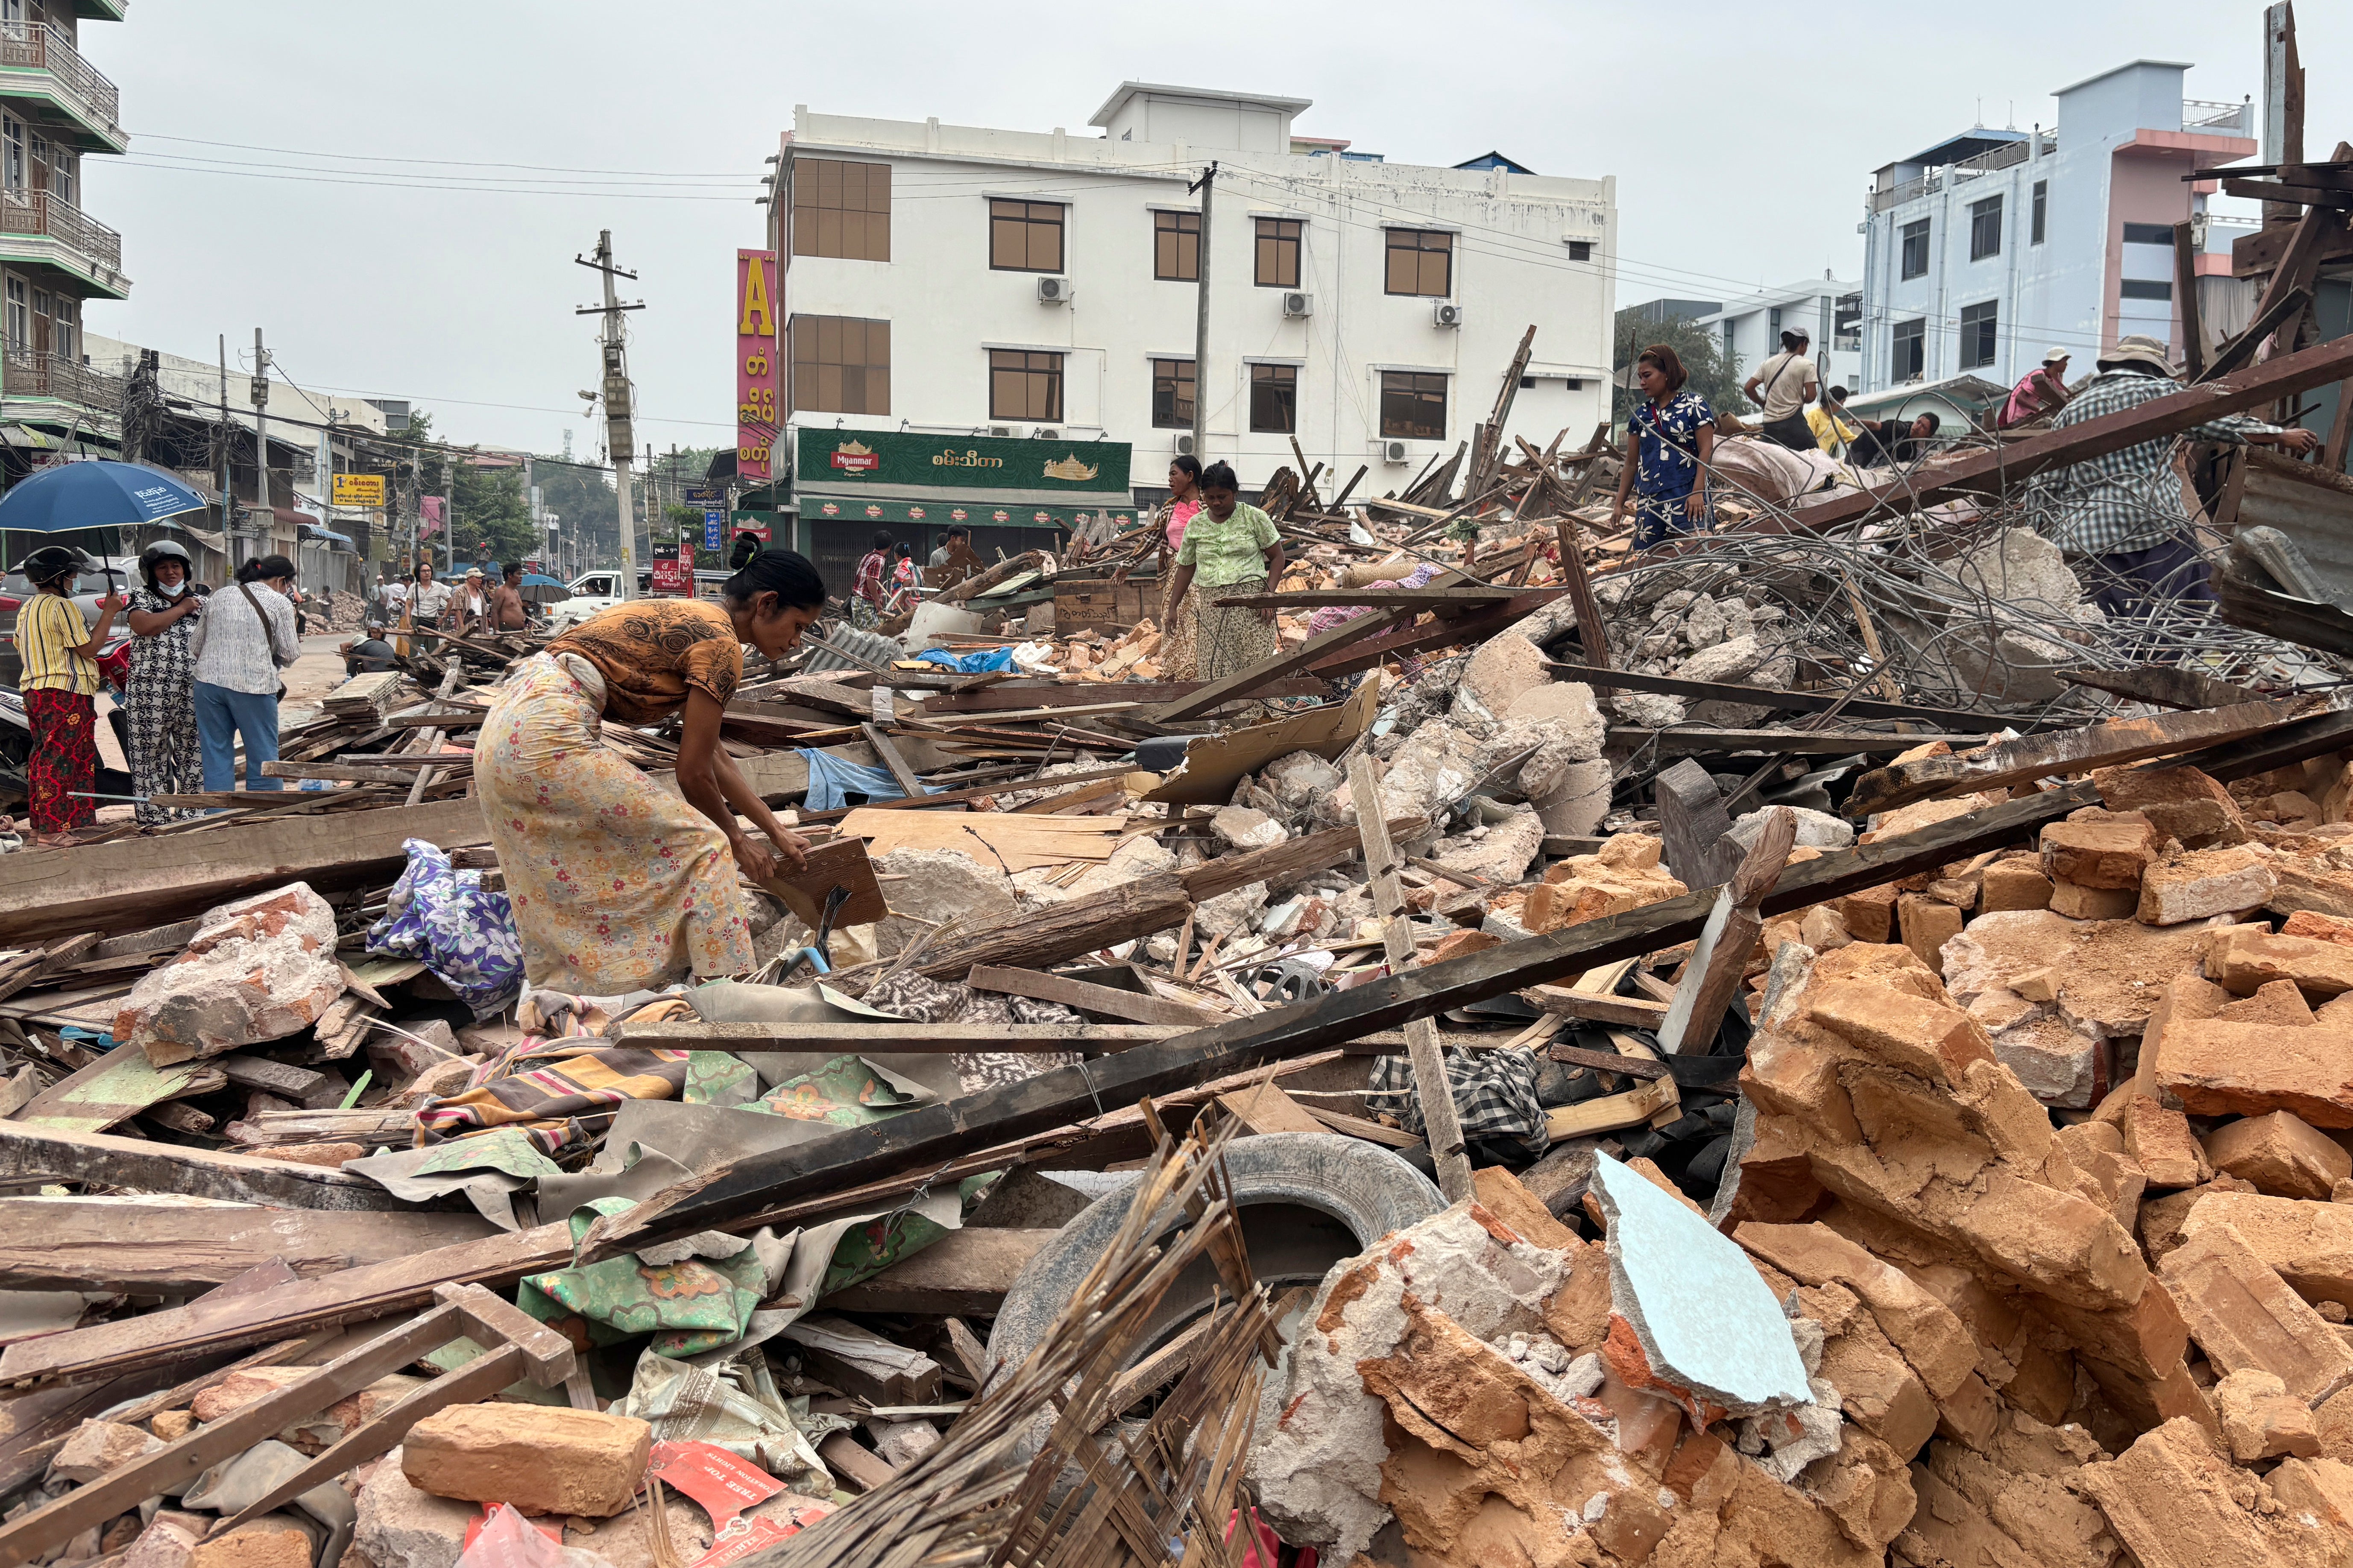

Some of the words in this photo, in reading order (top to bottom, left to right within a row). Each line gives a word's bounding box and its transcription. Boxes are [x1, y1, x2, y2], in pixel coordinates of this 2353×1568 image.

[837, 455, 872, 466] Myanmar
[735, 530, 767, 538] Mmar
[706, 1452, 736, 1471] LIGHTS
[704, 1466, 727, 1481] TOP
[726, 1480, 757, 1500] TREE
